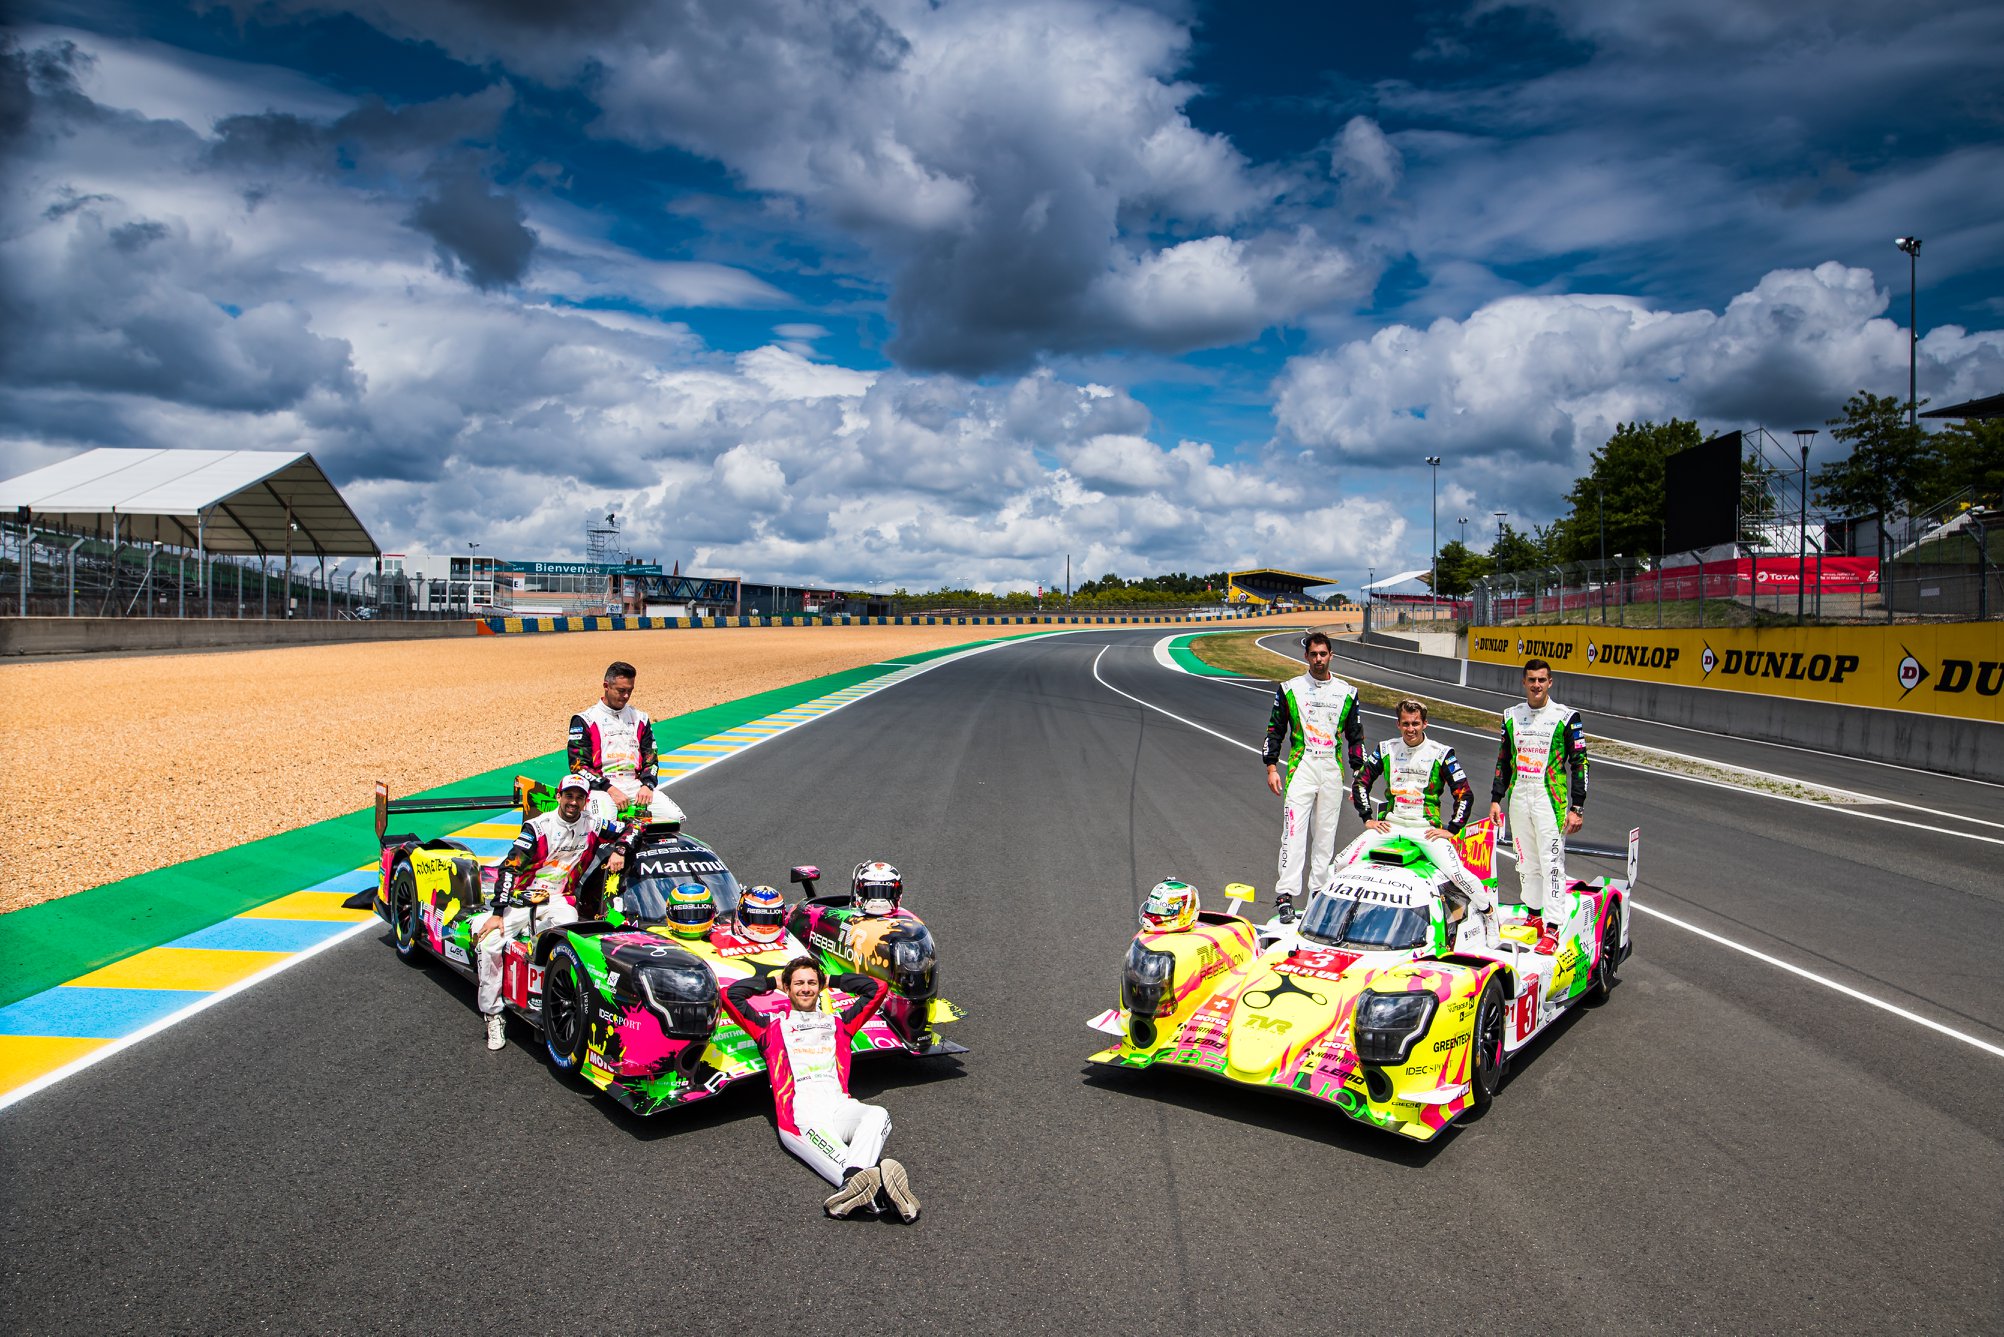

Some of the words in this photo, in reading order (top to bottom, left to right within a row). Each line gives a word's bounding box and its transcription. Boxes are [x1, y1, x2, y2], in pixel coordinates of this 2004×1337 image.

[536, 563, 600, 574] Bienvenue
[1480, 638, 1509, 653] DUNLOP
[1525, 640, 1573, 660] DUNLOP
[1600, 645, 1680, 669] DUNLOP
[1721, 650, 1859, 683] DUNLOP
[1336, 873, 1414, 893] REBELLION
[673, 903, 713, 911] REBELLION
[746, 907, 783, 916] REBELLION
[808, 930, 863, 966] REBELLION
[1303, 953, 1335, 968] 3
[510, 960, 518, 1001] 1
[529, 967, 545, 990] P1
[1192, 1014, 1228, 1027] MOTUL
[1246, 1014, 1294, 1034] TVR
[1524, 994, 1533, 1034] 3
[1183, 1036, 1226, 1050] LEMO
[1319, 1064, 1365, 1086] LEMO
[1405, 1065, 1429, 1076] IDEC
